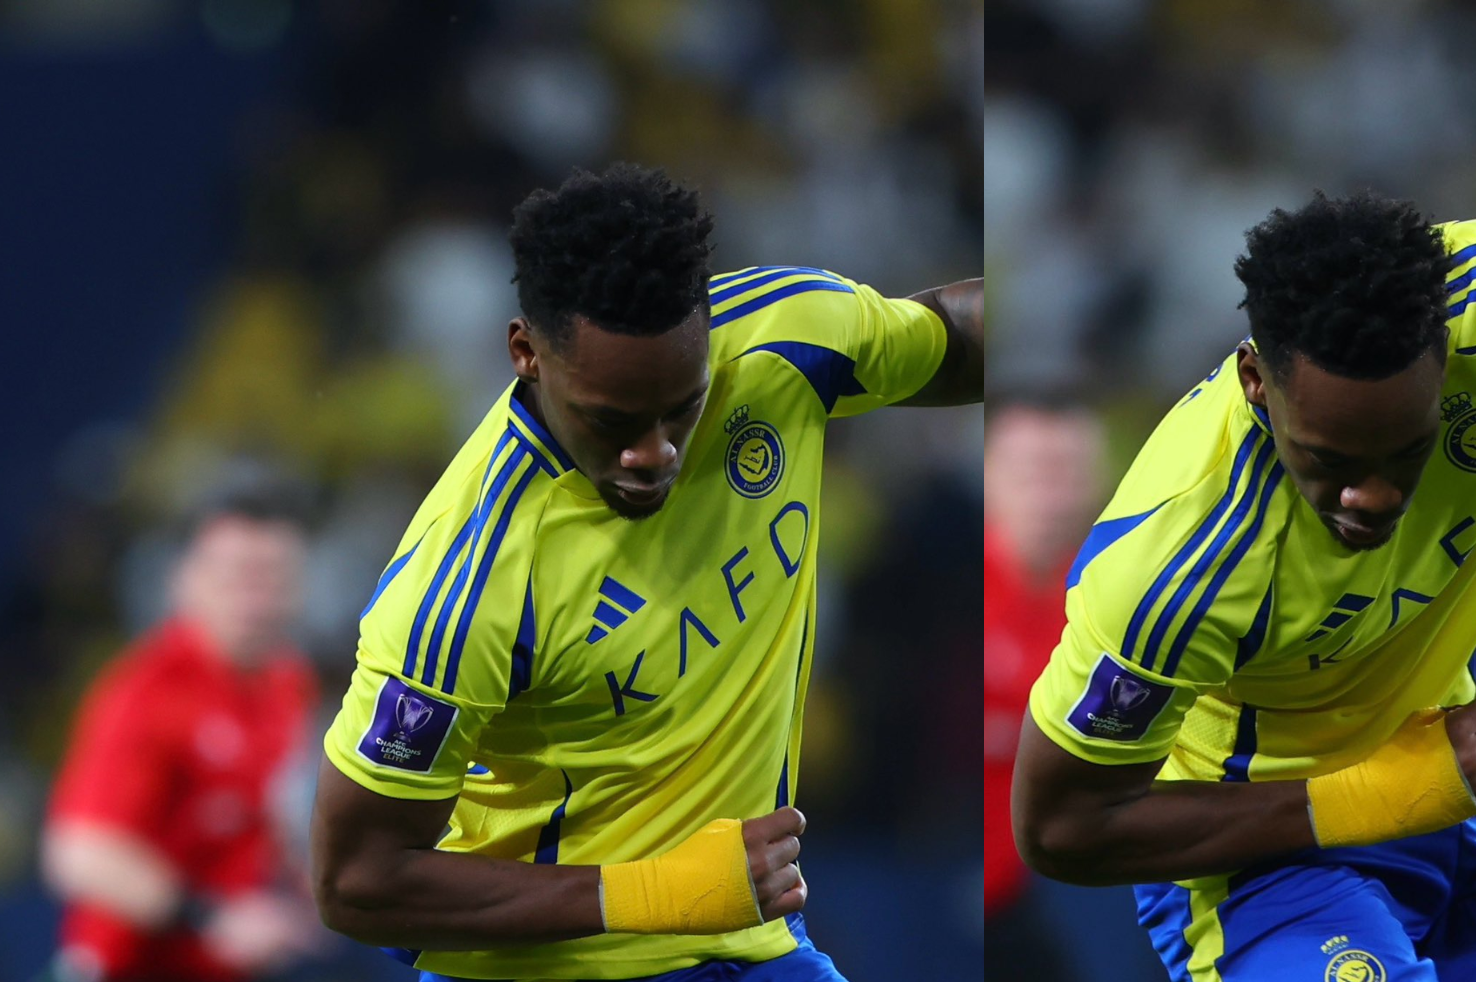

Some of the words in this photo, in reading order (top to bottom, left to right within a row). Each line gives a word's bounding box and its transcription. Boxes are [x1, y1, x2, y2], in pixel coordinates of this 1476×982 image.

[604, 501, 809, 716] KAFD
[375, 737, 421, 756] CHAMPIONS
[381, 746, 412, 760] LEAGUE
[383, 753, 405, 763] ELITE
